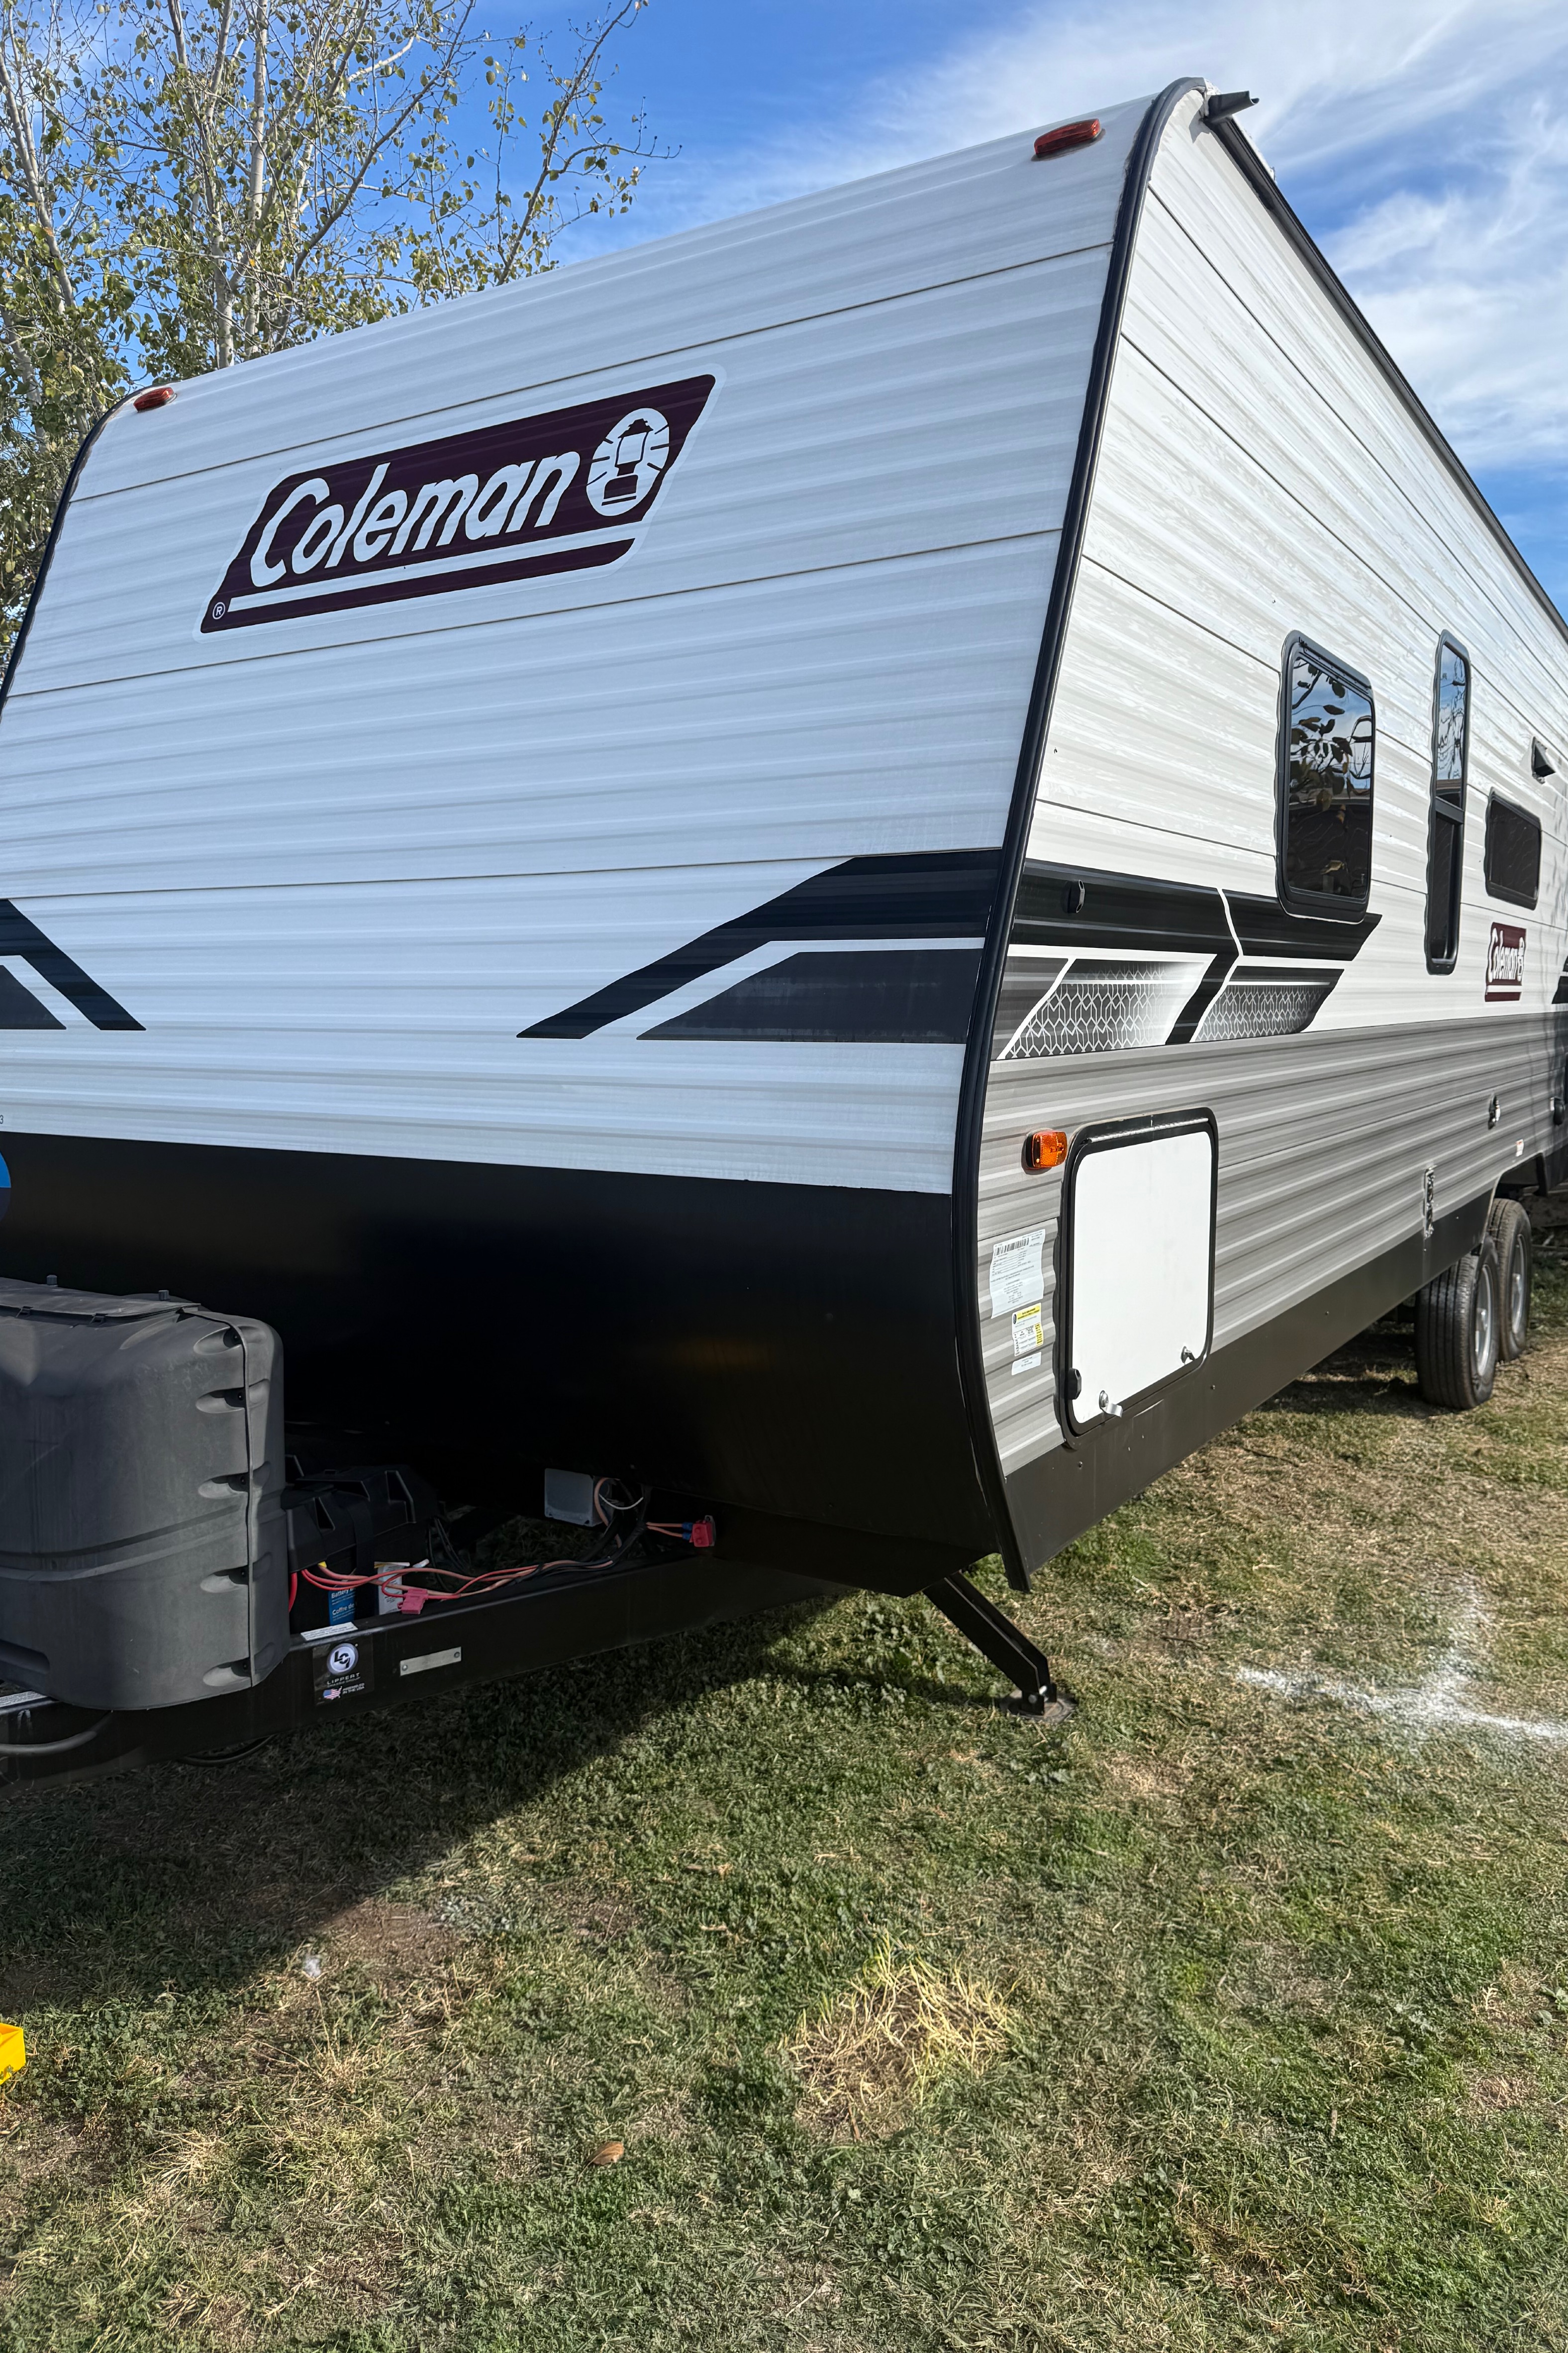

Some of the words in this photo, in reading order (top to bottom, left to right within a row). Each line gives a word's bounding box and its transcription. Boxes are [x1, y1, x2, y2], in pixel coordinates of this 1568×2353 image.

[251, 451, 580, 587] Coleman
[1488, 928, 1518, 983] Coleman
[332, 1606, 348, 1615] Coffre
[327, 1672, 360, 1685] LIPPERT
